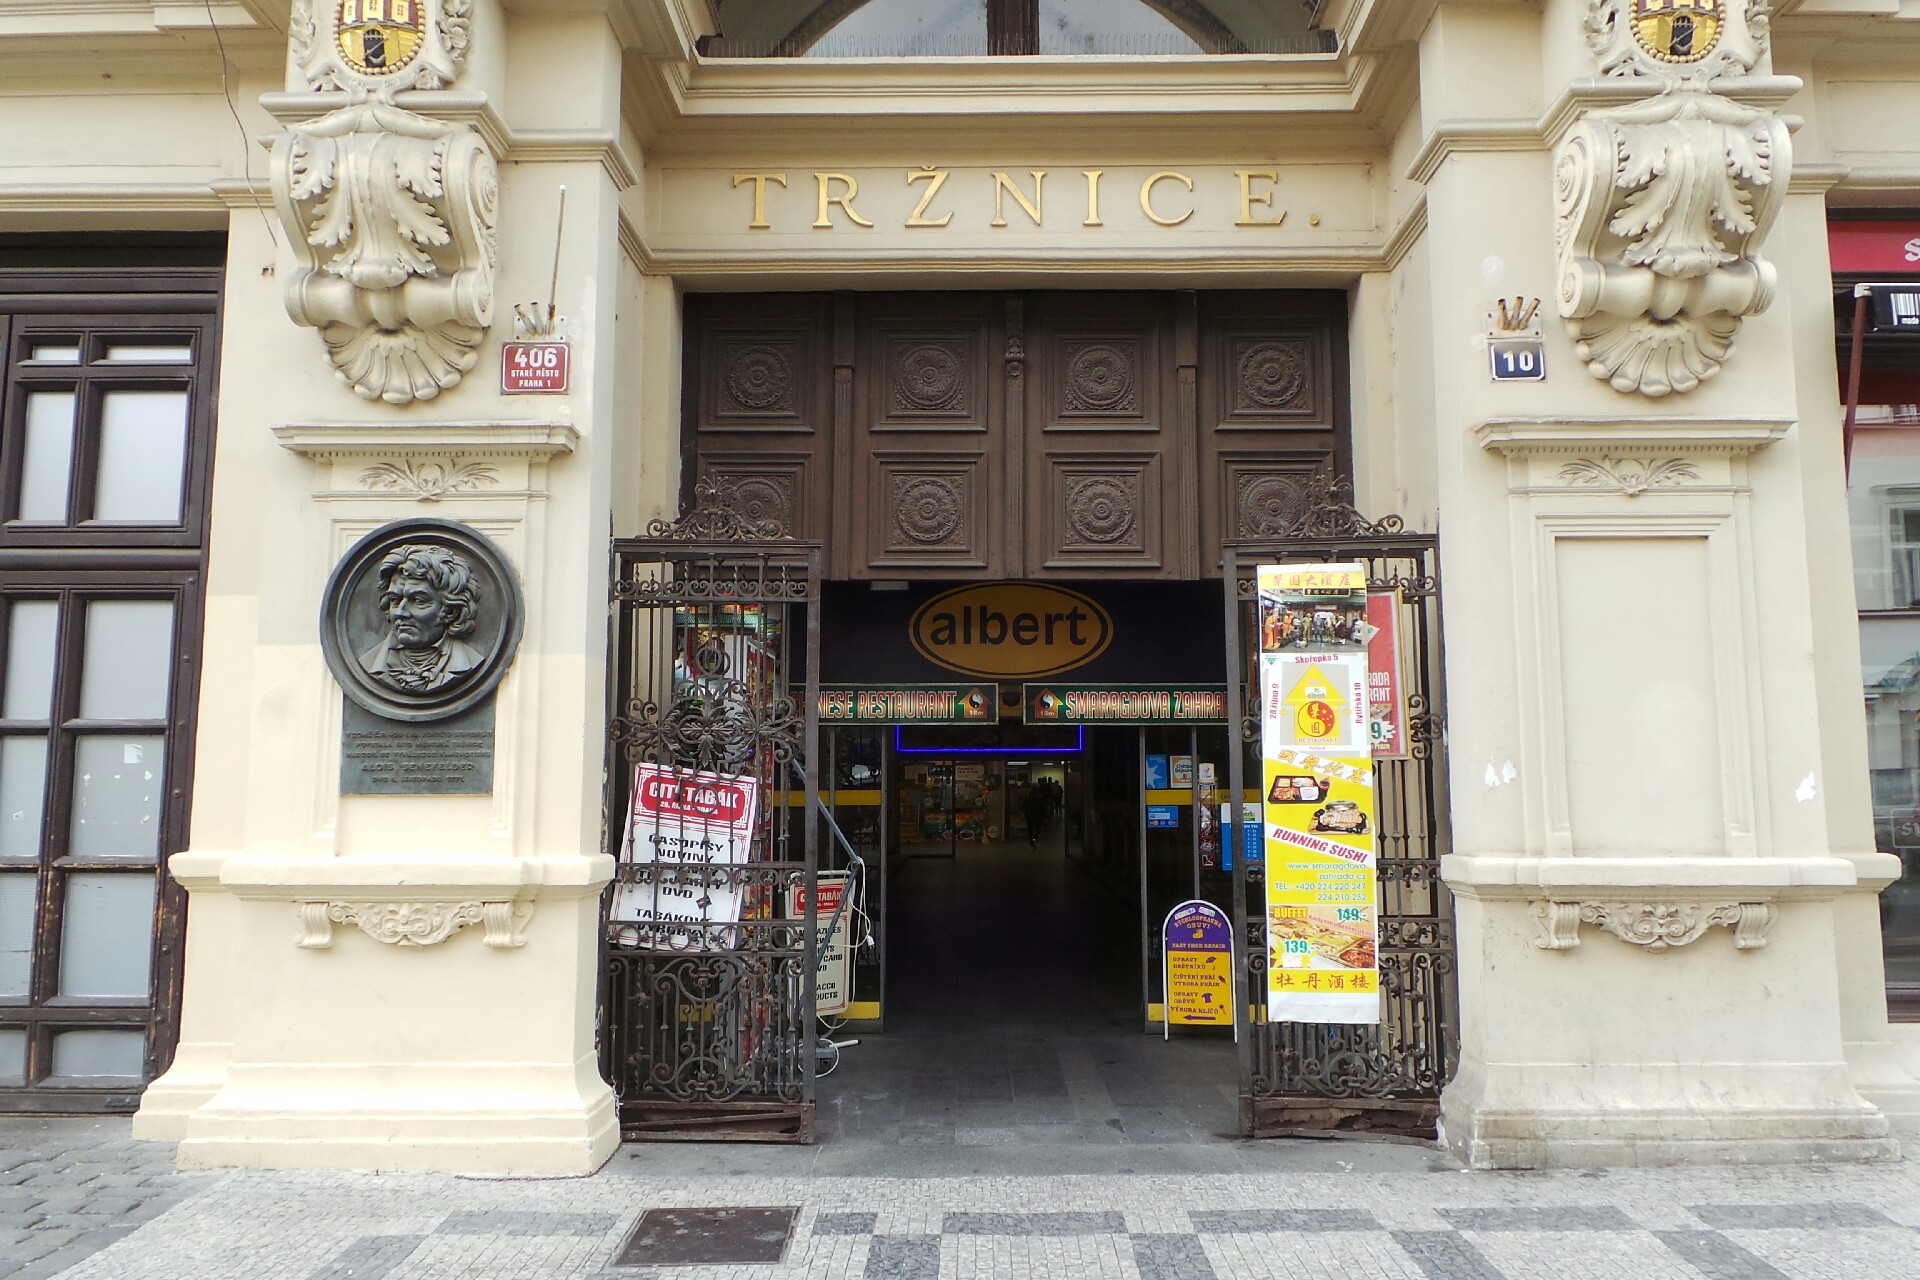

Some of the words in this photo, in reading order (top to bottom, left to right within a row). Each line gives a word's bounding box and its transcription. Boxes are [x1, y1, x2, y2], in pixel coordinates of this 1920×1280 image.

[733, 165, 1319, 228] TRŽNICE.
[514, 347, 557, 368] 406
[1503, 350, 1534, 372] 10
[511, 368, 533, 377] STARÉ
[536, 368, 559, 377] MĚSTO
[930, 605, 1087, 646] albert
[1295, 654, 1332, 664] Skořepka
[1333, 654, 1339, 662] 5
[1354, 682, 1362, 691] 10
[789, 691, 853, 719] CHNESE
[857, 691, 957, 719] RESTAURANT
[1065, 691, 1170, 719] SMARAGDOVA
[362, 763, 395, 772] ALOIS
[1272, 828, 1329, 852] RUNNING
[1329, 844, 1369, 864] SUSHI
[662, 886, 693, 899] DVD
[1274, 907, 1308, 919] BUFFET
[823, 954, 843, 962] CARD
[1276, 972, 1370, 989] 牡丹酒楼
